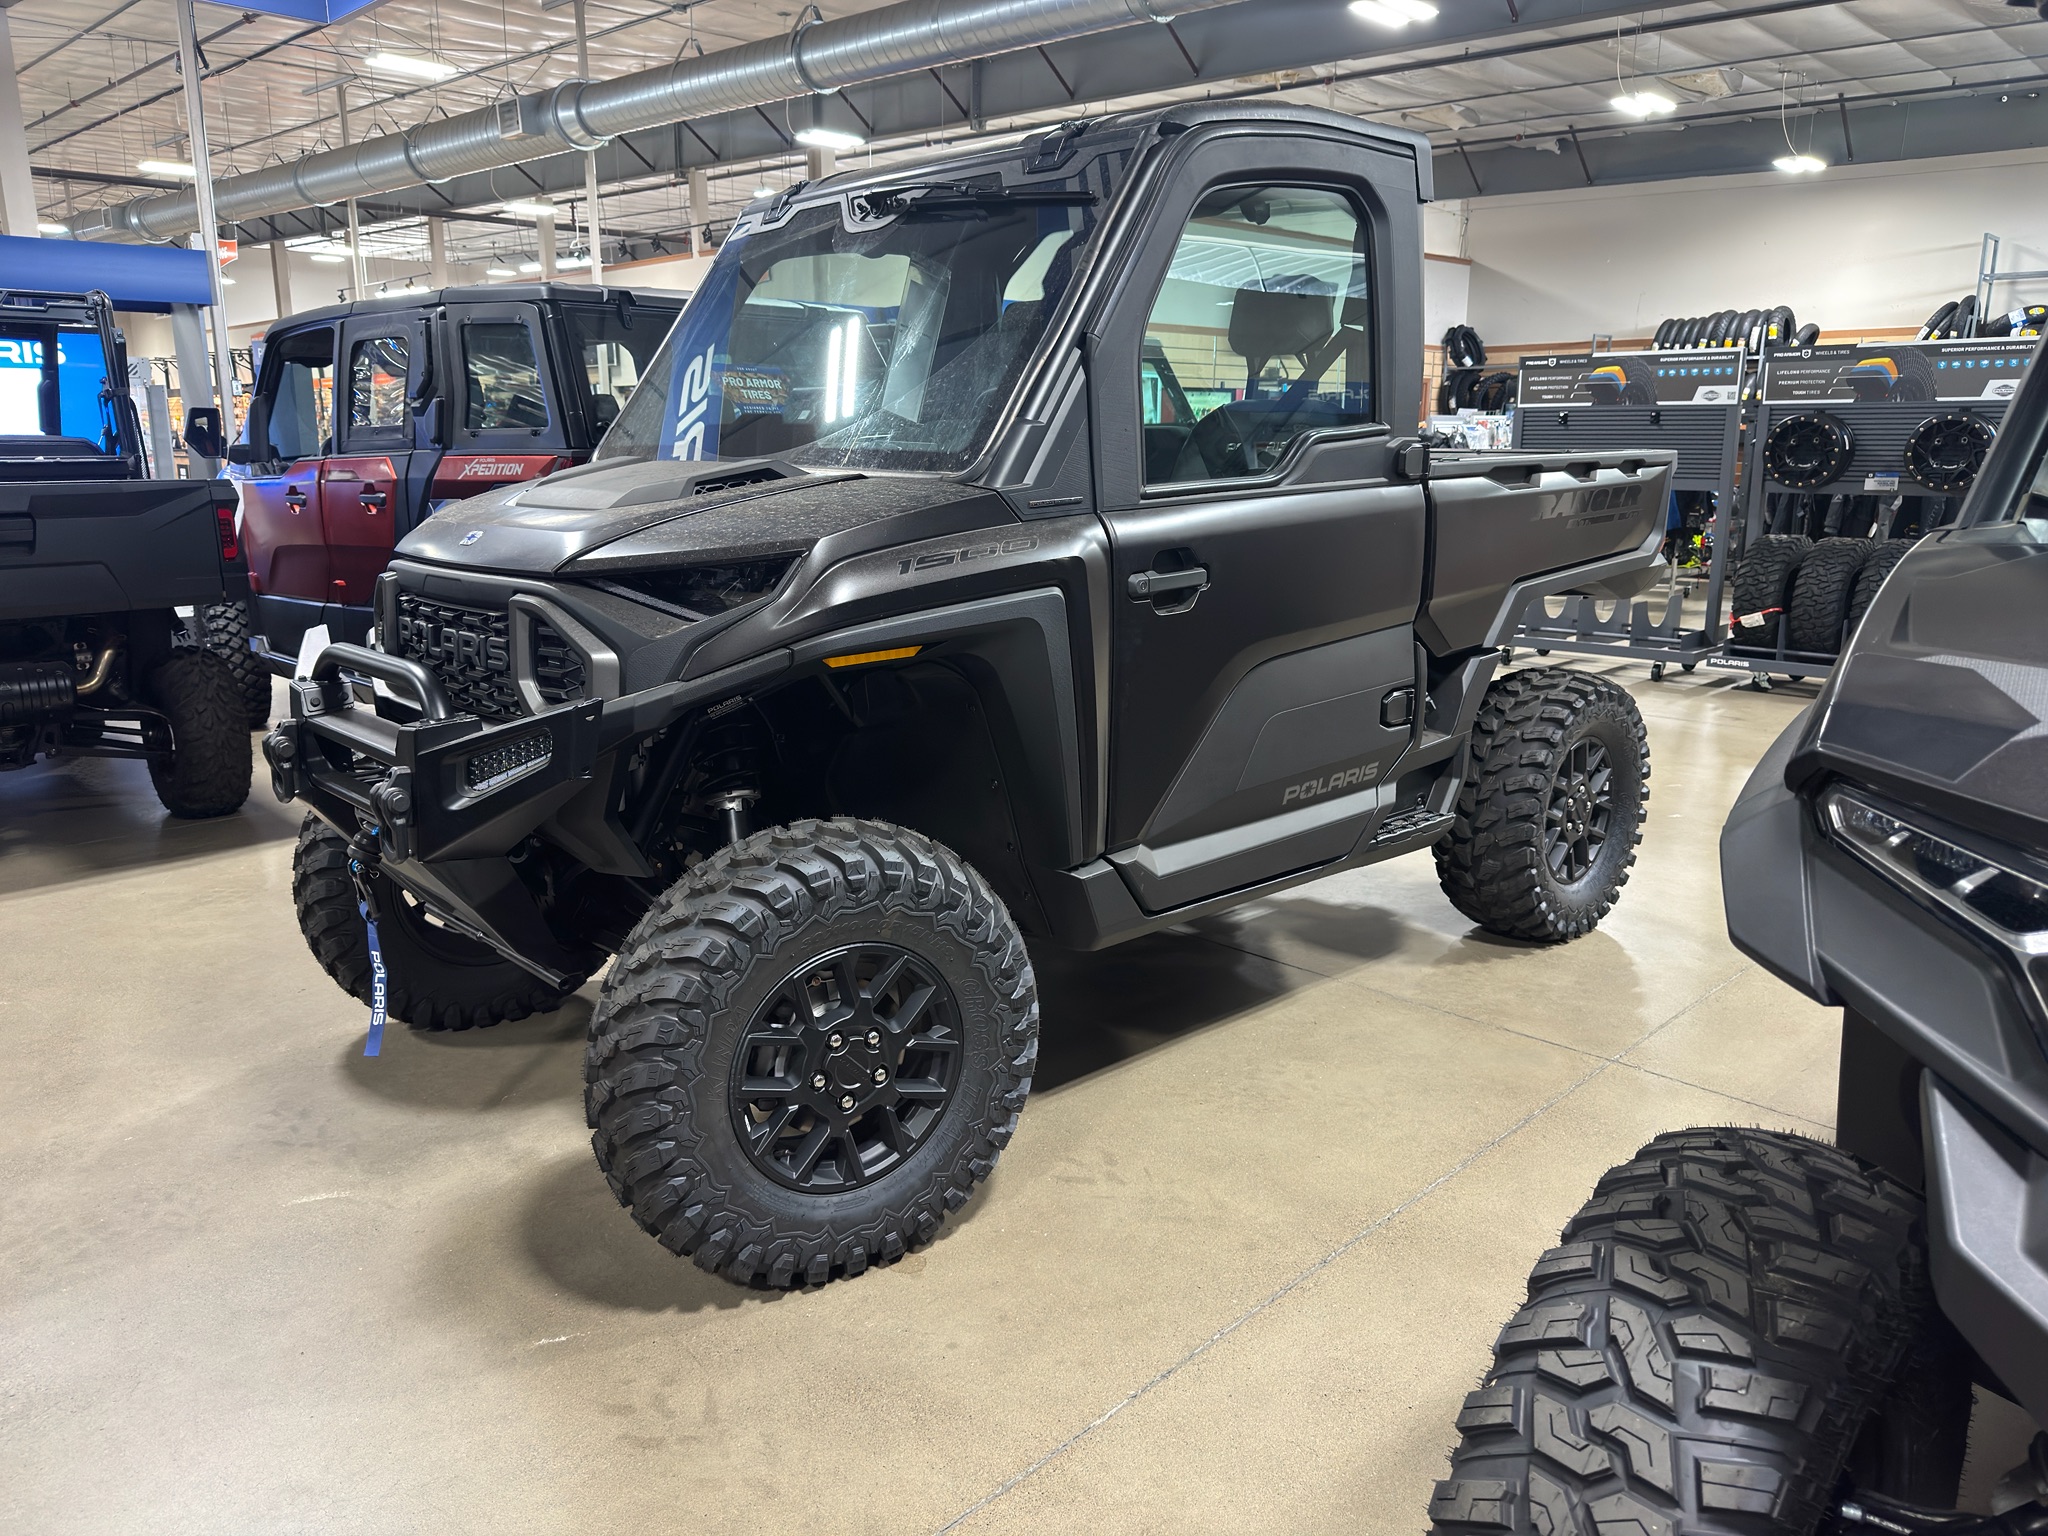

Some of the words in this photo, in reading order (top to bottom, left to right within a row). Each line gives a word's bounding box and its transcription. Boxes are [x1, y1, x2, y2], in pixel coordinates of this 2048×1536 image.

[2006, 343, 2036, 351] DURABILITY
[722, 376, 744, 387] PRO
[746, 377, 782, 389] ARMOR
[741, 389, 772, 400] TIRES
[457, 459, 524, 480] XPEDITION
[1536, 484, 1642, 521] RANGER
[896, 535, 1039, 576] 1500
[400, 616, 510, 672] POLARIS
[1710, 658, 1750, 667] POLARIS
[1282, 760, 1380, 805] POLARIS
[370, 950, 387, 1025] POLARIS
